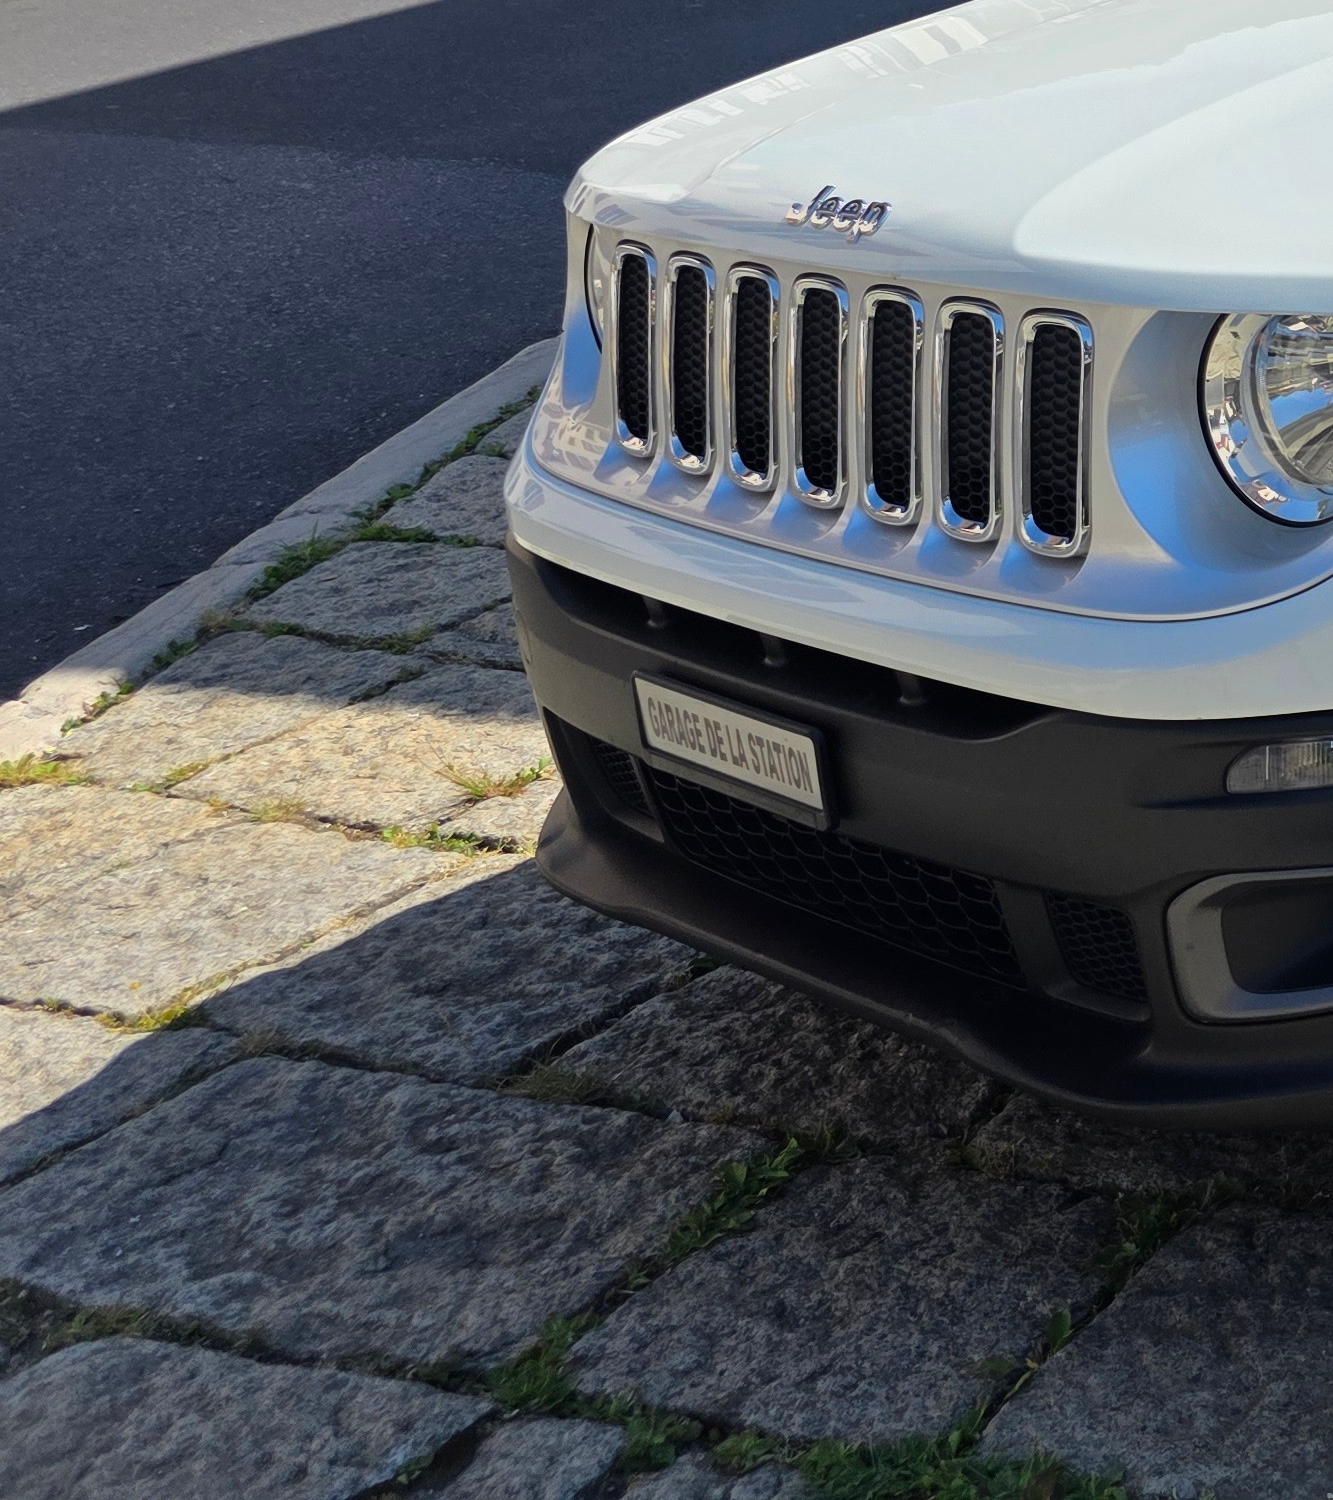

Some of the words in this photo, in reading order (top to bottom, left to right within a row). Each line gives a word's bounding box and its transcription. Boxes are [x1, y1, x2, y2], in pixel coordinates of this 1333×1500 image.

[786, 185, 892, 244] Jeep
[647, 696, 706, 755] GARAGE
[704, 717, 728, 762] DE
[725, 724, 750, 771] LA
[747, 732, 814, 794] STATION
